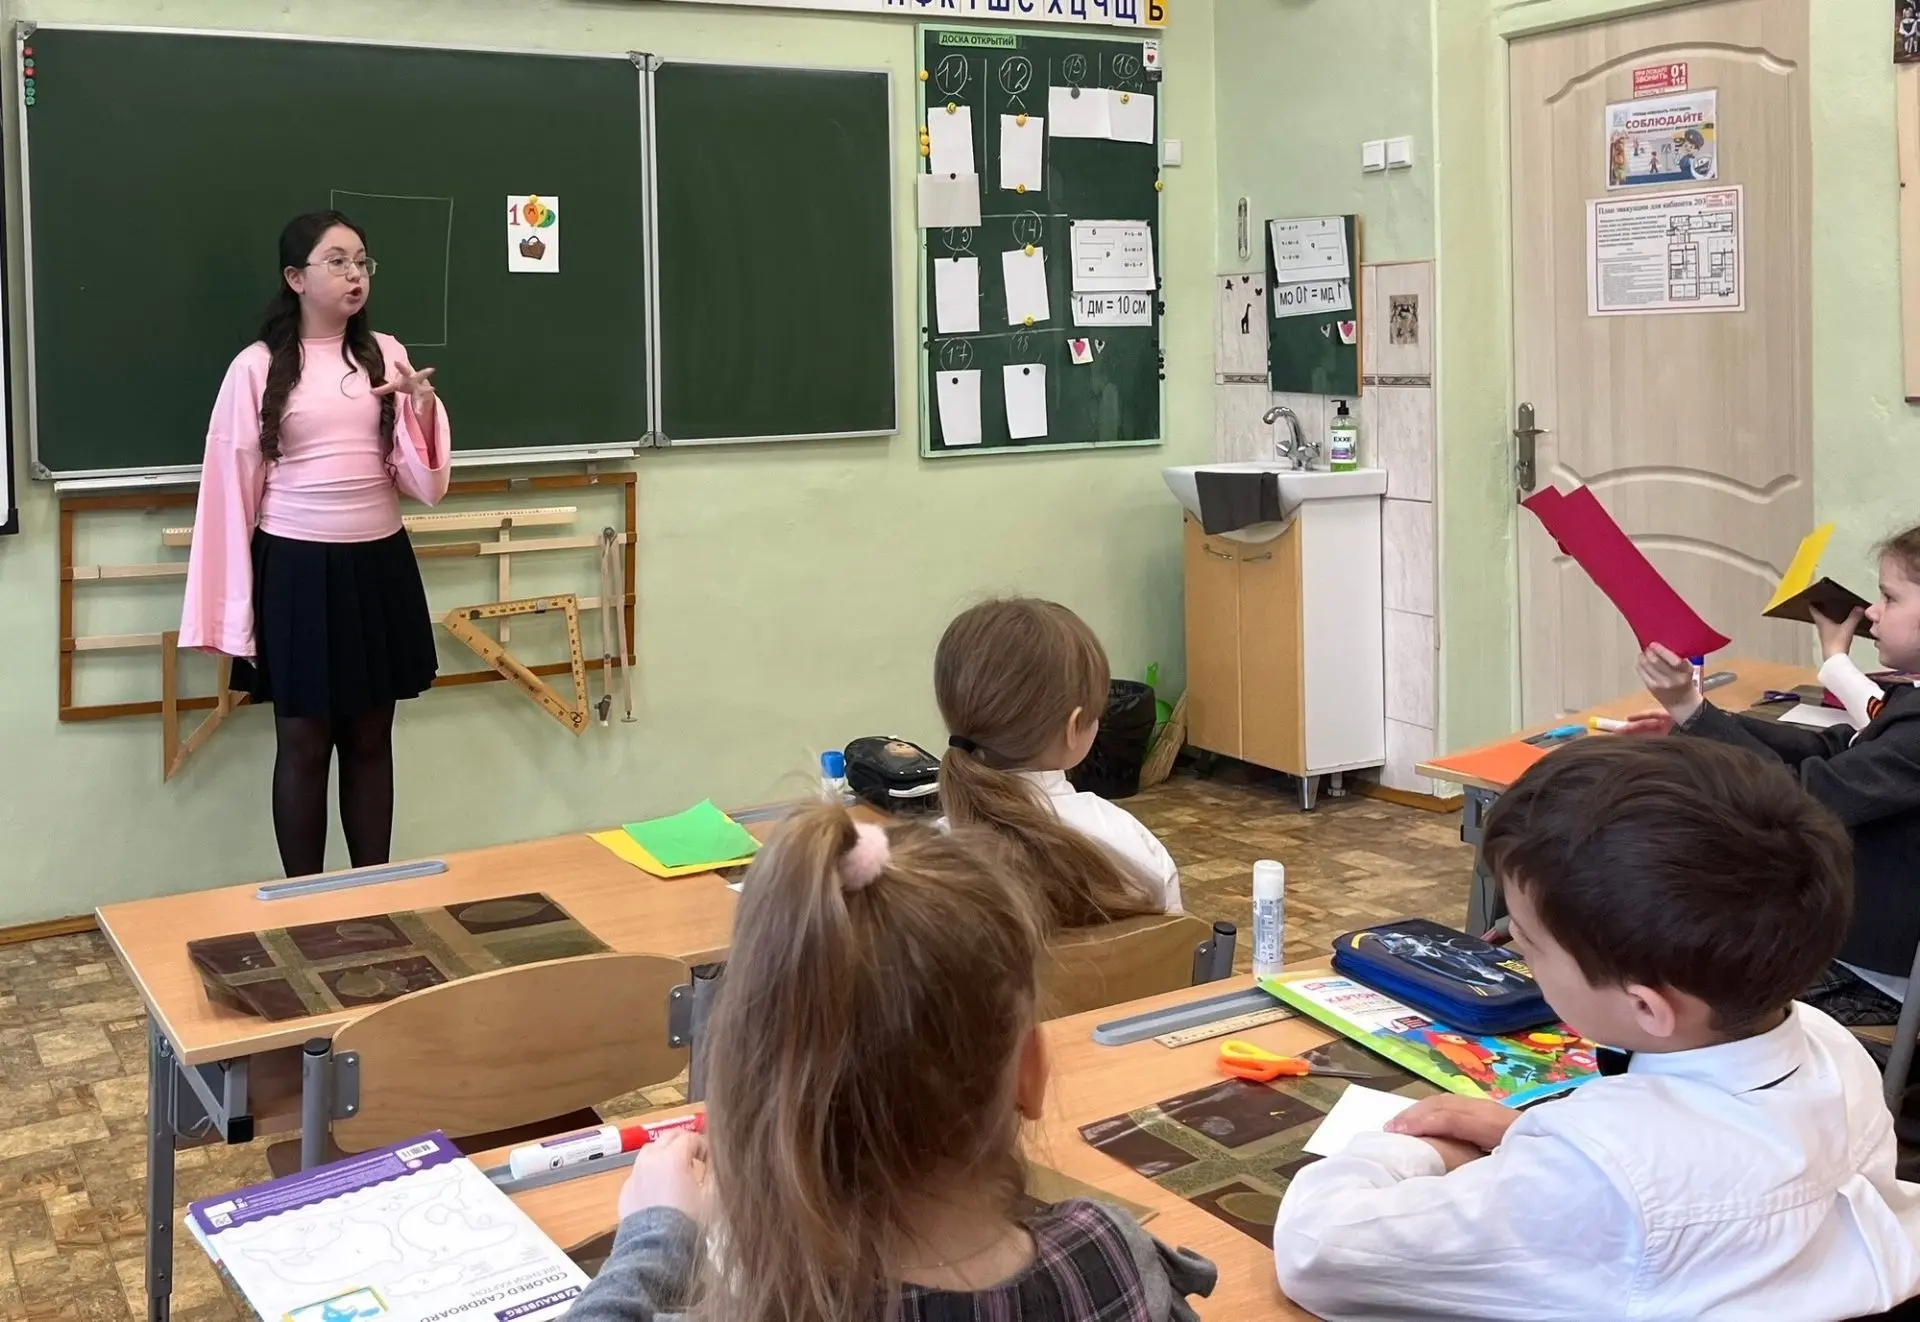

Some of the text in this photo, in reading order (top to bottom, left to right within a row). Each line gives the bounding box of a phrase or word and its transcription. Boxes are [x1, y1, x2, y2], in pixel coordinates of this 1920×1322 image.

[940, 34, 1015, 47] ДОСКА ОТКРЫТИЙ
[1001, 62, 1029, 89] 12
[1670, 63, 1686, 78] 01
[1625, 111, 1703, 130] СОБЛЮДАЙТЕ
[509, 203, 521, 226] 1
[1078, 295, 1147, 318] 1 дм = 10 см
[420, 1271, 568, 1322] COLORED CARDBOARD
[505, 1291, 567, 1318] BRAUBERG
